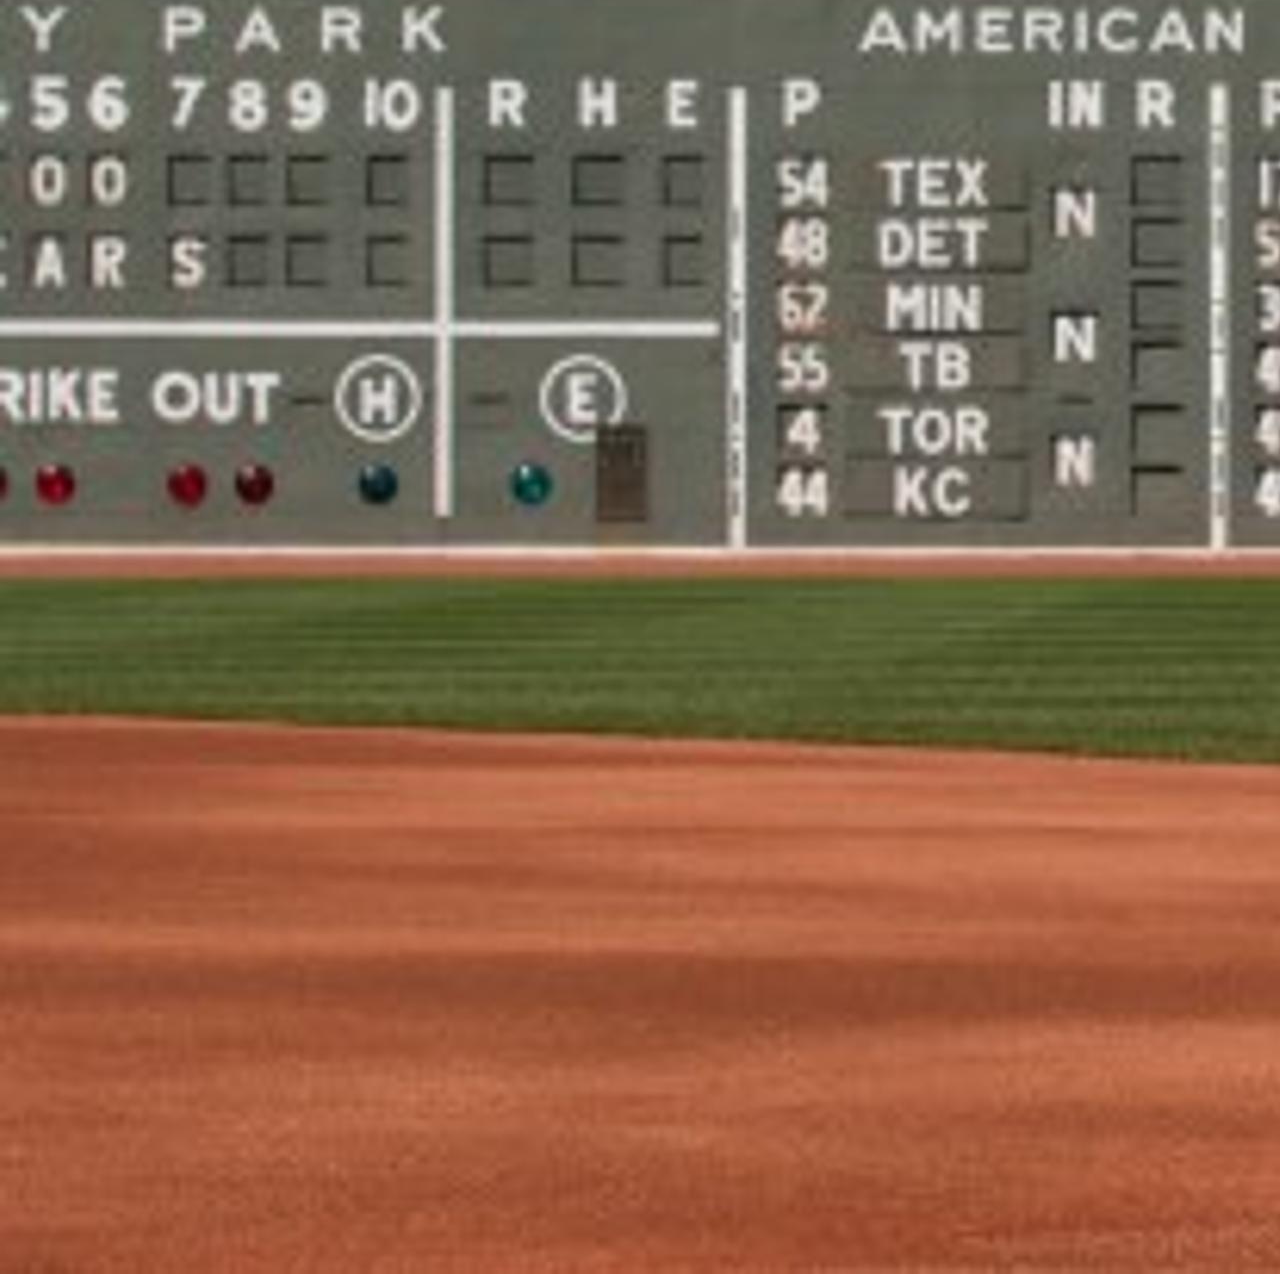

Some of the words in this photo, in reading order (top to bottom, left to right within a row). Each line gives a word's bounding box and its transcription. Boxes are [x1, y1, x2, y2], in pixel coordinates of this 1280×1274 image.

[859, 7, 1244, 53] AMERICAN
[171, 76, 206, 127] 7
[229, 79, 268, 131] 8
[289, 79, 327, 131] 9
[364, 79, 420, 131] 10
[489, 79, 527, 127] R
[579, 78, 617, 127] H
[668, 79, 697, 127] E
[784, 79, 820, 126] P
[1049, 80, 1102, 127] IN
[1137, 79, 1175, 127] R
[779, 160, 828, 206] 54
[881, 159, 987, 207] TEX
[1056, 191, 1095, 237] N
[778, 219, 828, 266] 48
[879, 218, 988, 267] DET
[887, 284, 981, 330] MIN
[1055, 317, 1095, 361] N
[780, 345, 829, 391] 55
[899, 341, 970, 390] TB
[152, 371, 280, 423] OUT
[360, 376, 396, 423] H
[568, 374, 596, 423] E
[787, 409, 821, 454] 4
[880, 407, 988, 455] TOR
[1057, 437, 1093, 485] N
[778, 471, 828, 515] 44
[894, 466, 970, 515] KC
